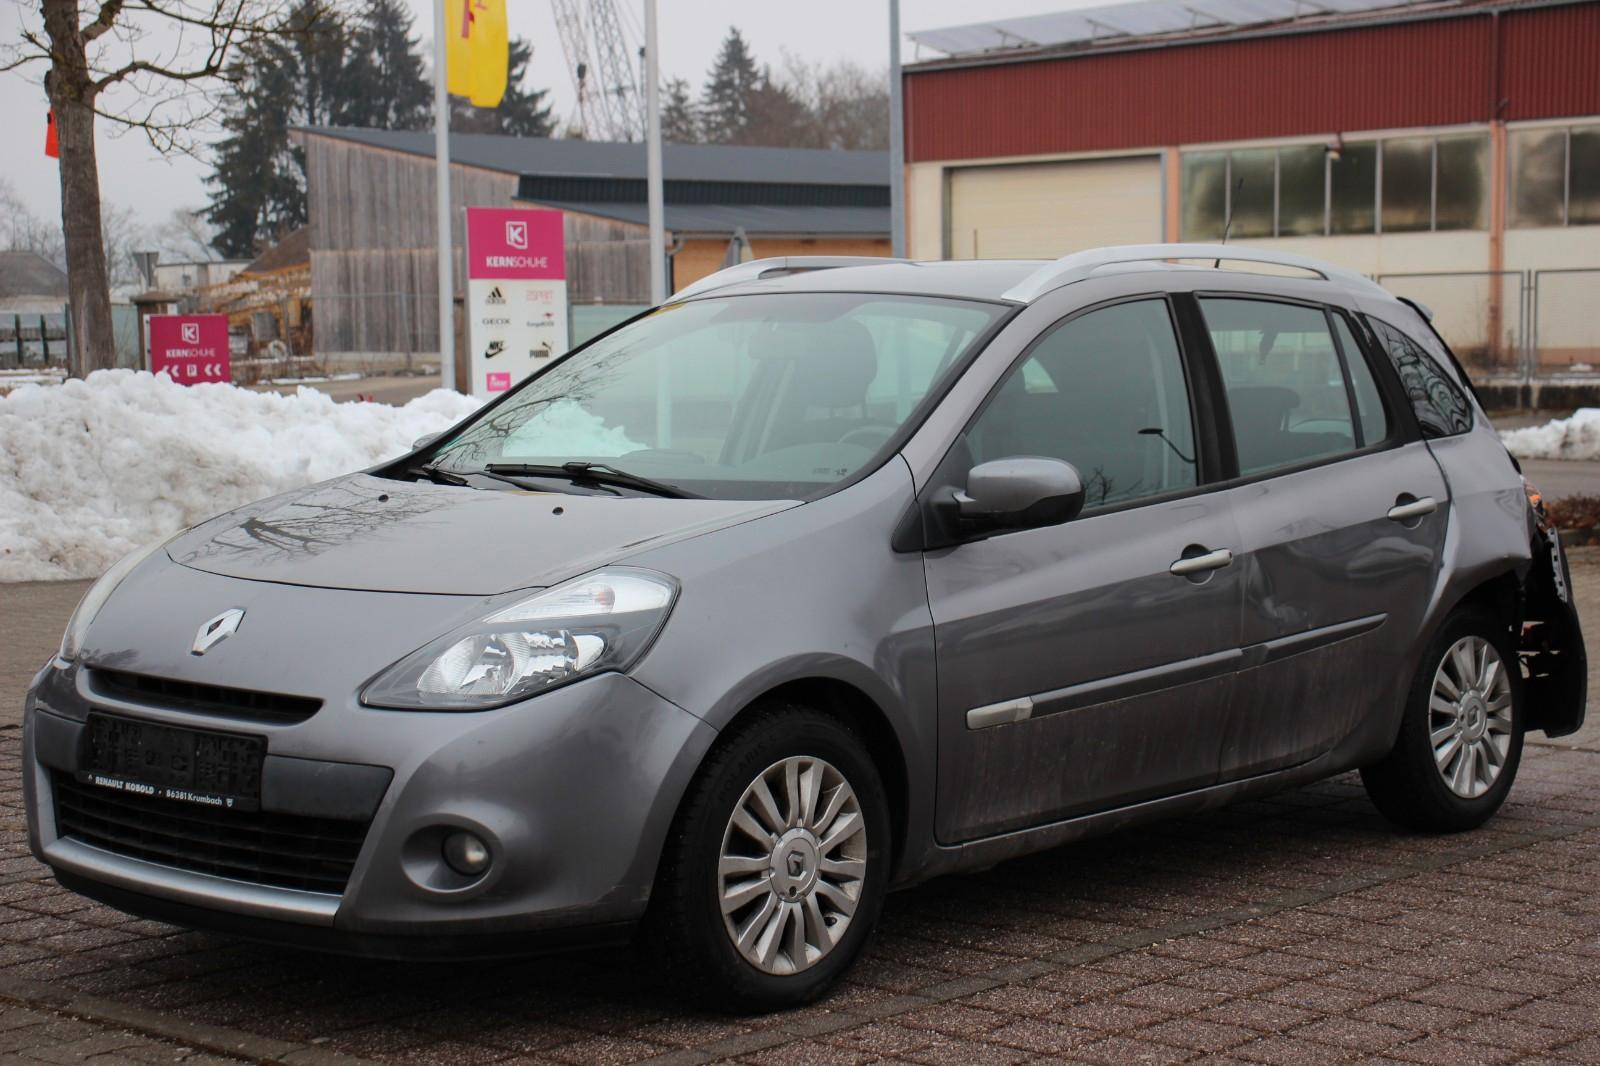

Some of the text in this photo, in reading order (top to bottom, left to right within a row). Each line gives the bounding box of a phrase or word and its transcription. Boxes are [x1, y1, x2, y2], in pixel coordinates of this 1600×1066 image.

[486, 255, 548, 268] KERNSCHUHE
[481, 318, 511, 326] GEOX
[95, 776, 223, 806] RENAULT KOBOLD 86381 Krumbach
